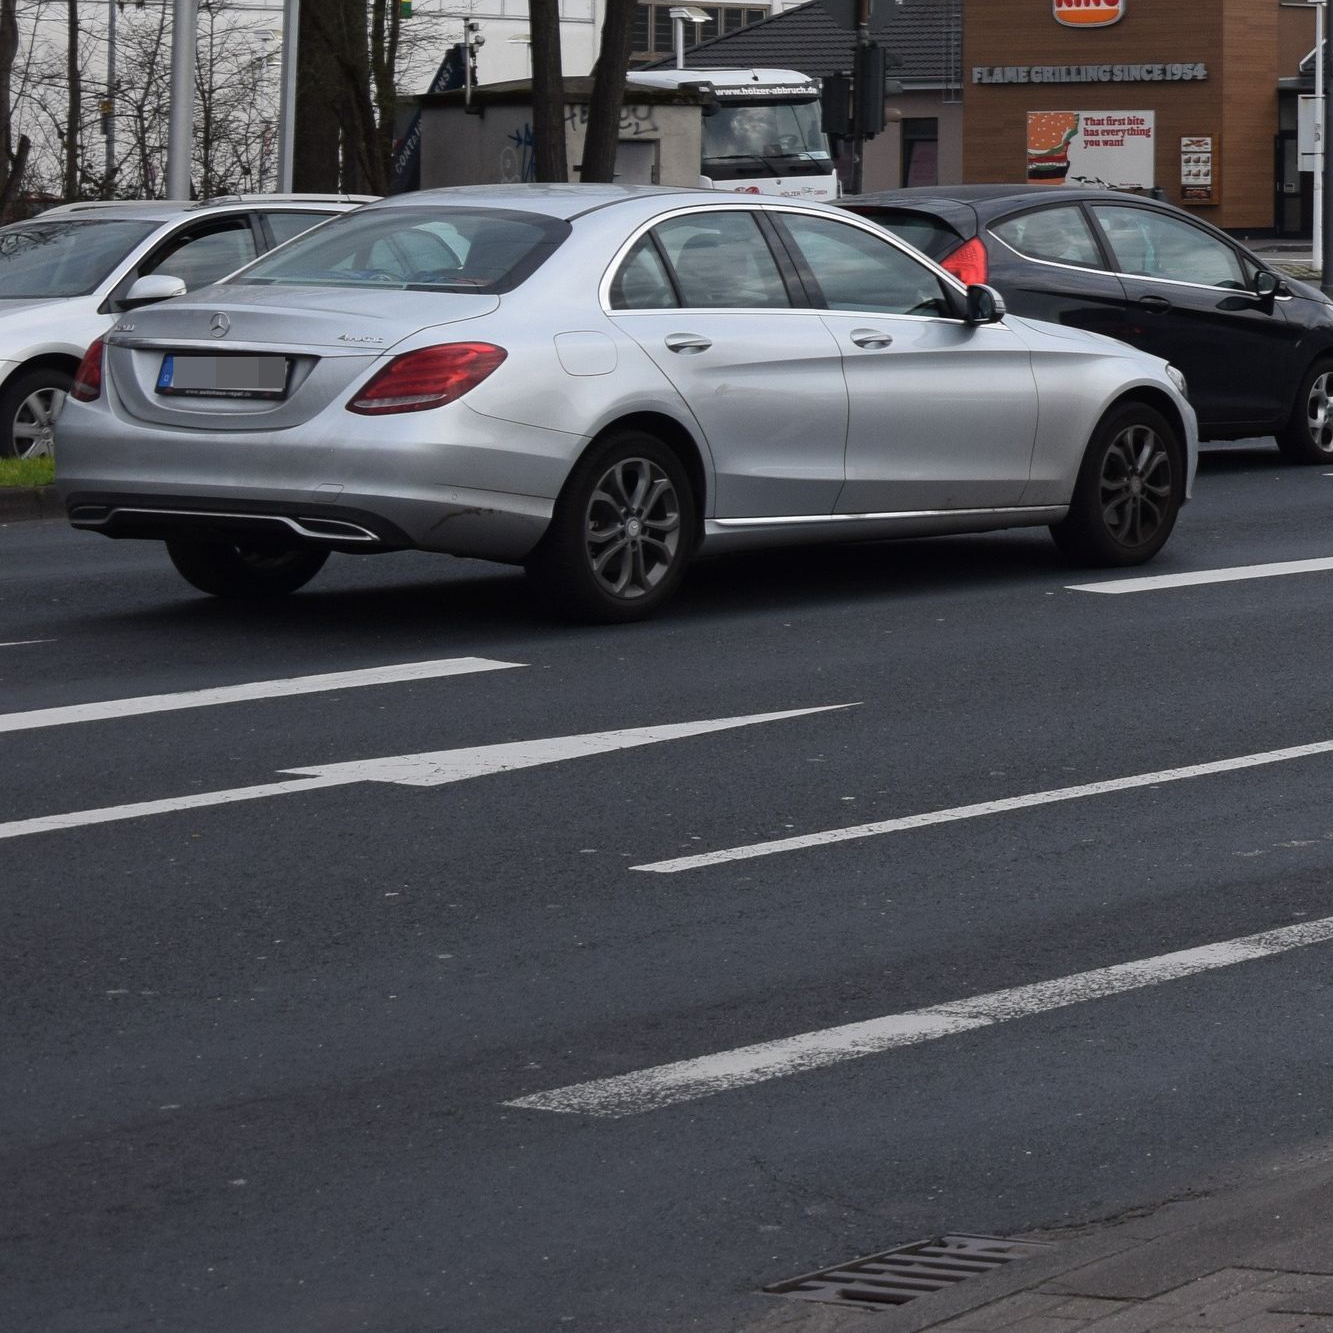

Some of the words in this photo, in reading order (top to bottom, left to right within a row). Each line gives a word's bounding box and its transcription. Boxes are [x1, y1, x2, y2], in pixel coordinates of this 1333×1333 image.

[972, 66, 1029, 84] FLAME
[1029, 65, 1112, 83] GRILLING
[1112, 64, 1165, 82] SINCE
[1166, 62, 1208, 81] 1954
[715, 87, 818, 96] www.hölzer-abbruch.de
[1084, 116, 1105, 126] That
[1105, 115, 1127, 126] first
[1127, 115, 1145, 126] bite
[1084, 126, 1100, 136] has
[1101, 126, 1151, 139] everything
[1084, 139, 1101, 149] you
[1102, 138, 1125, 147] want
